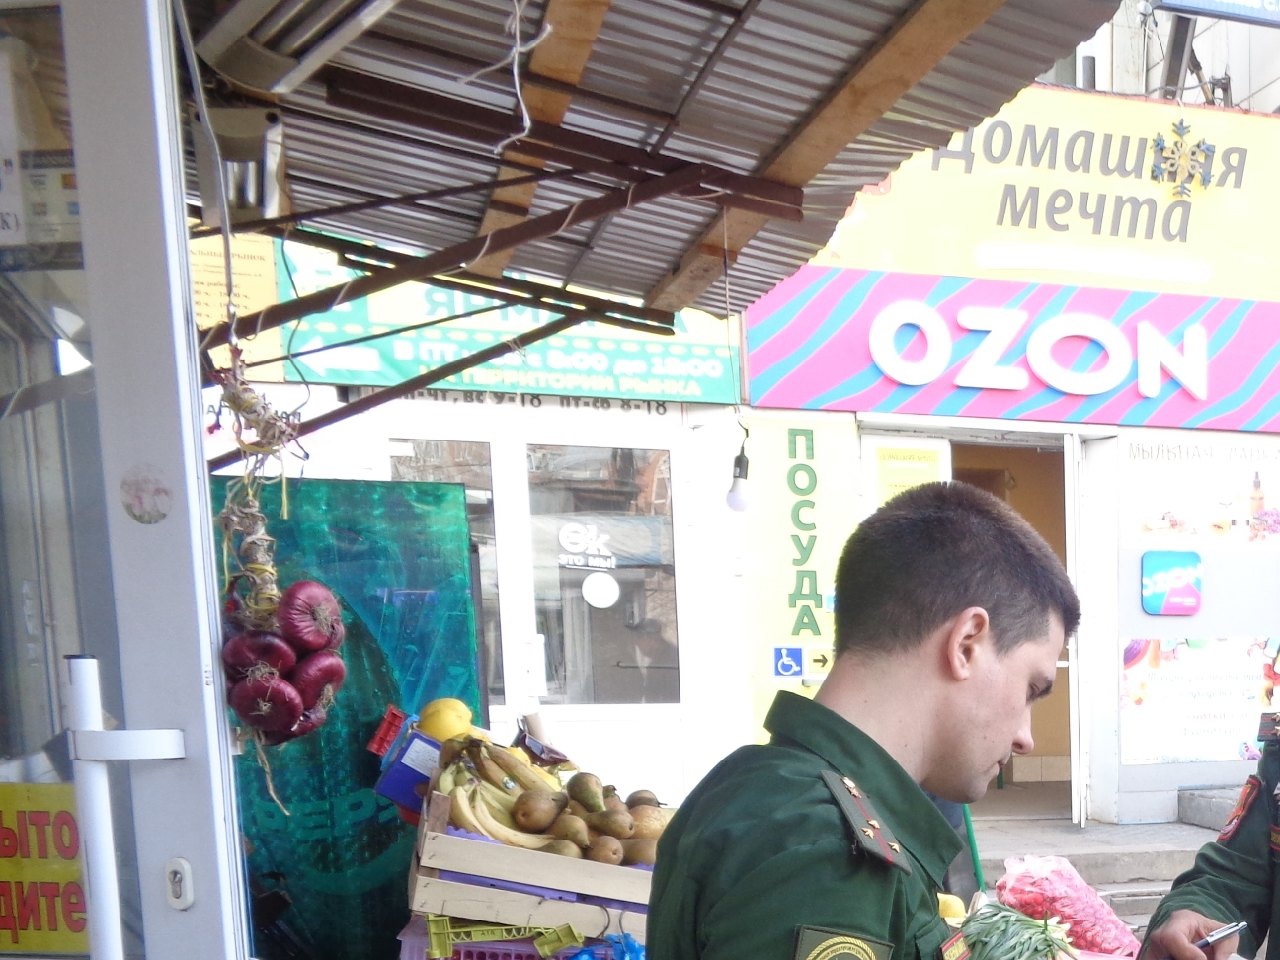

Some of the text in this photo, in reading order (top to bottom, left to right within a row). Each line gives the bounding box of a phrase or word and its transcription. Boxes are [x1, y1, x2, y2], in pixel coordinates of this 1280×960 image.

[996, 183, 1192, 243] мечта
[868, 298, 1208, 401] OZON
[786, 428, 823, 636] ПОСУДА
